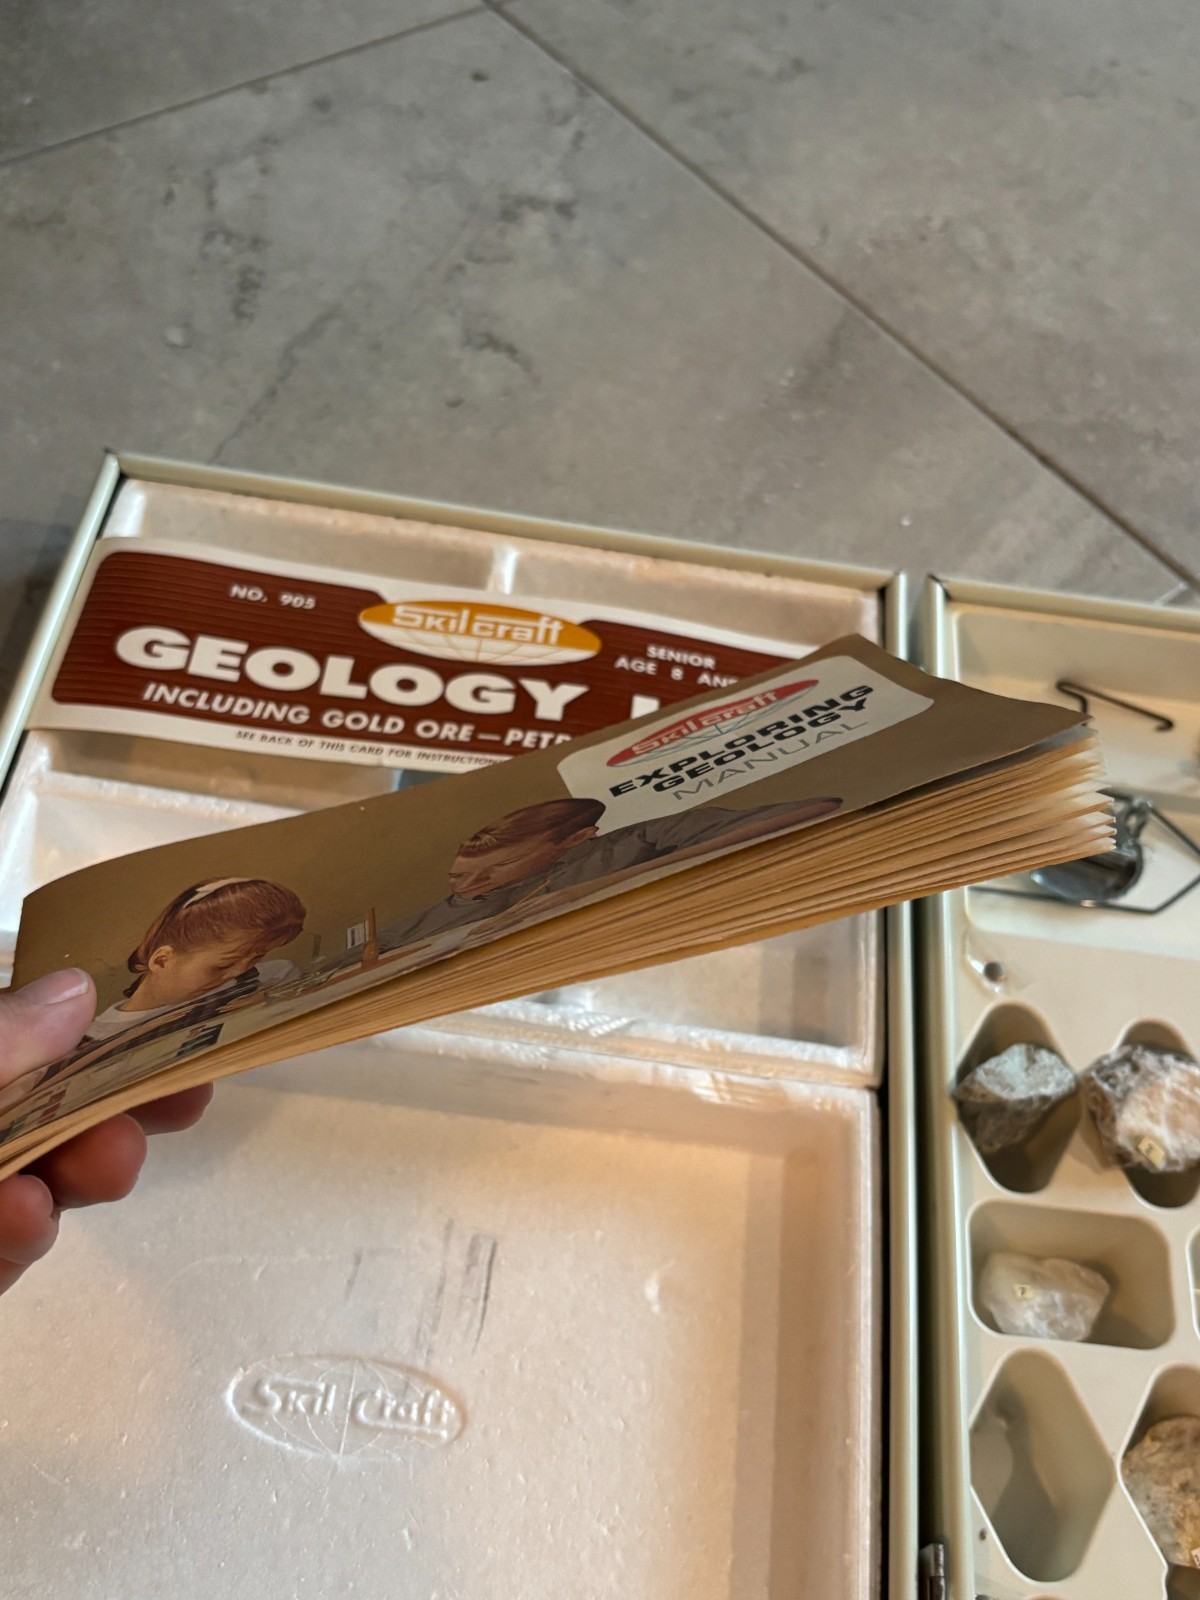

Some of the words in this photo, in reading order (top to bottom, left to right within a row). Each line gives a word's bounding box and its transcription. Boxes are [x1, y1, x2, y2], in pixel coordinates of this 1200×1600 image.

[229, 584, 268, 603] NO.
[279, 592, 316, 610] 905
[391, 604, 564, 646] Skilcraft
[115, 624, 590, 722] GEOLOGY
[613, 655, 657, 676] AGE
[670, 666, 683, 681] 8
[646, 645, 716, 669] SENIOR
[143, 682, 310, 725] INCLUDING
[321, 708, 405, 736] GOLD
[631, 690, 780, 755] Skilcraft
[235, 730, 255, 741] SEE
[258, 734, 293, 746] BACK
[299, 738, 315, 748] OF
[320, 741, 345, 753] THIS
[350, 744, 384, 756] CARD
[609, 684, 875, 798] EXPLORING
[652, 696, 869, 793] GEOLOGY
[672, 720, 869, 800] MANUAL
